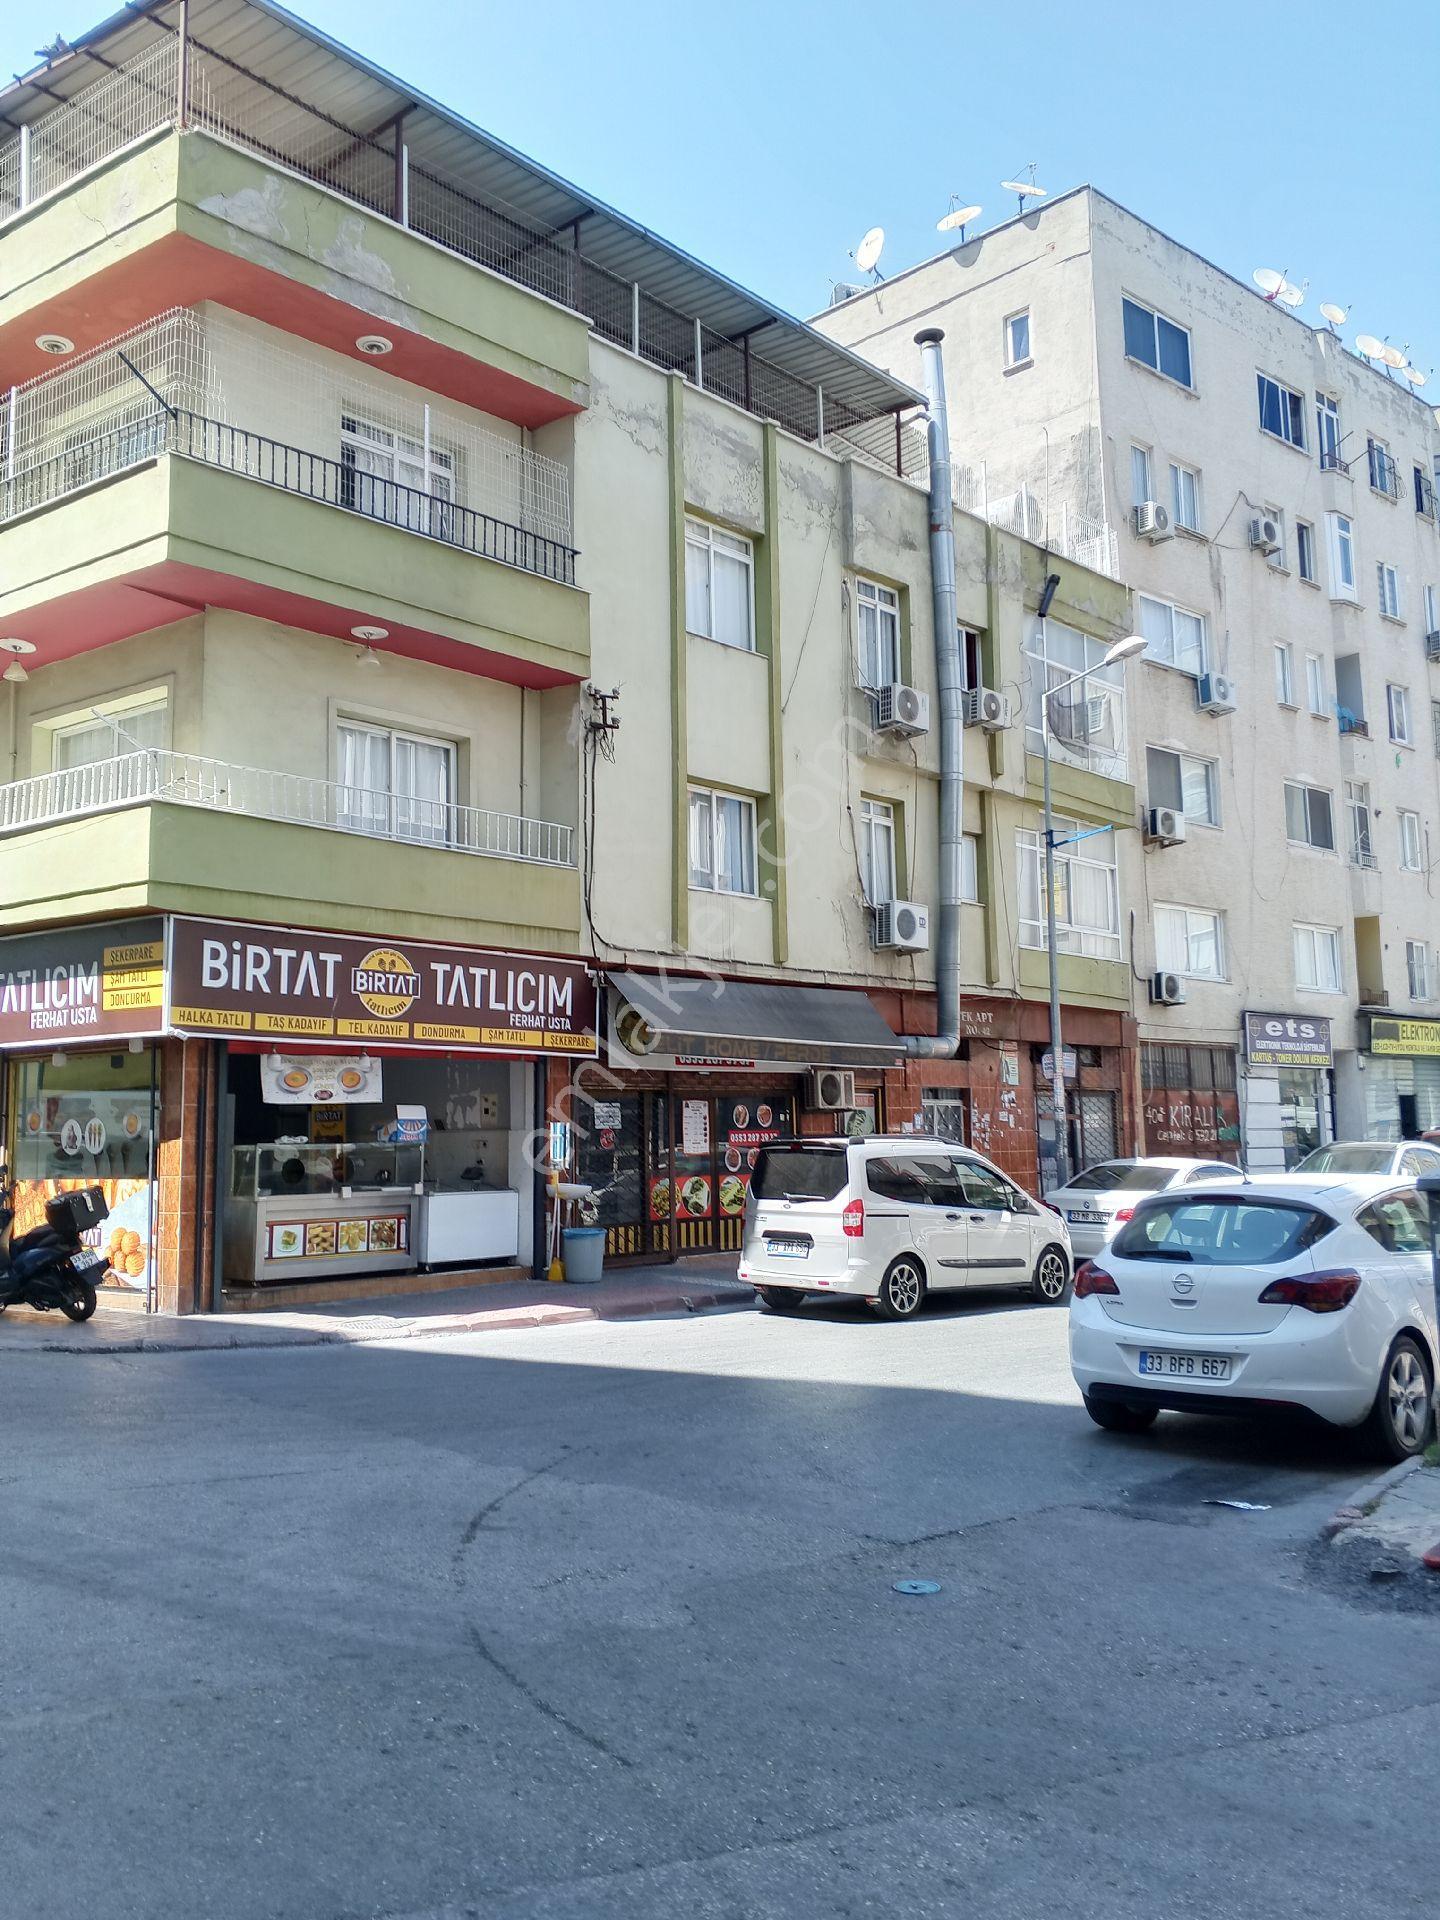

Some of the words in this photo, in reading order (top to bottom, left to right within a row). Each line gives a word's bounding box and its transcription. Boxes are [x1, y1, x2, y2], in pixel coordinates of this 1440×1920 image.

[430, 962, 573, 1016] TATLICIM
[30, 1009, 69, 1029] FERHAT
[71, 1006, 97, 1025] USTA
[178, 1010, 213, 1024] HALKA
[216, 1012, 244, 1026] TATLI
[267, 1016, 285, 1030] TAŞ
[288, 1016, 328, 1031] KADAYIF
[509, 1013, 545, 1029] FERHAT
[548, 1016, 571, 1030] USTA
[975, 1012, 993, 1023] APT
[349, 1022, 365, 1034] TEL
[367, 1022, 404, 1036] KADAYIF
[421, 1026, 466, 1039] DONDURMA
[488, 1029, 504, 1041] ŞAM
[505, 1030, 526, 1042] TATLI
[1265, 1019, 1316, 1038] ets
[550, 1035, 590, 1048] ŞEKERPARE
[705, 1037, 761, 1059] HOME
[774, 1043, 830, 1063] PERDE
[1147, 1355, 1163, 1372] 33
[1169, 1356, 1194, 1374] BFB
[1202, 1359, 1228, 1377] 667
